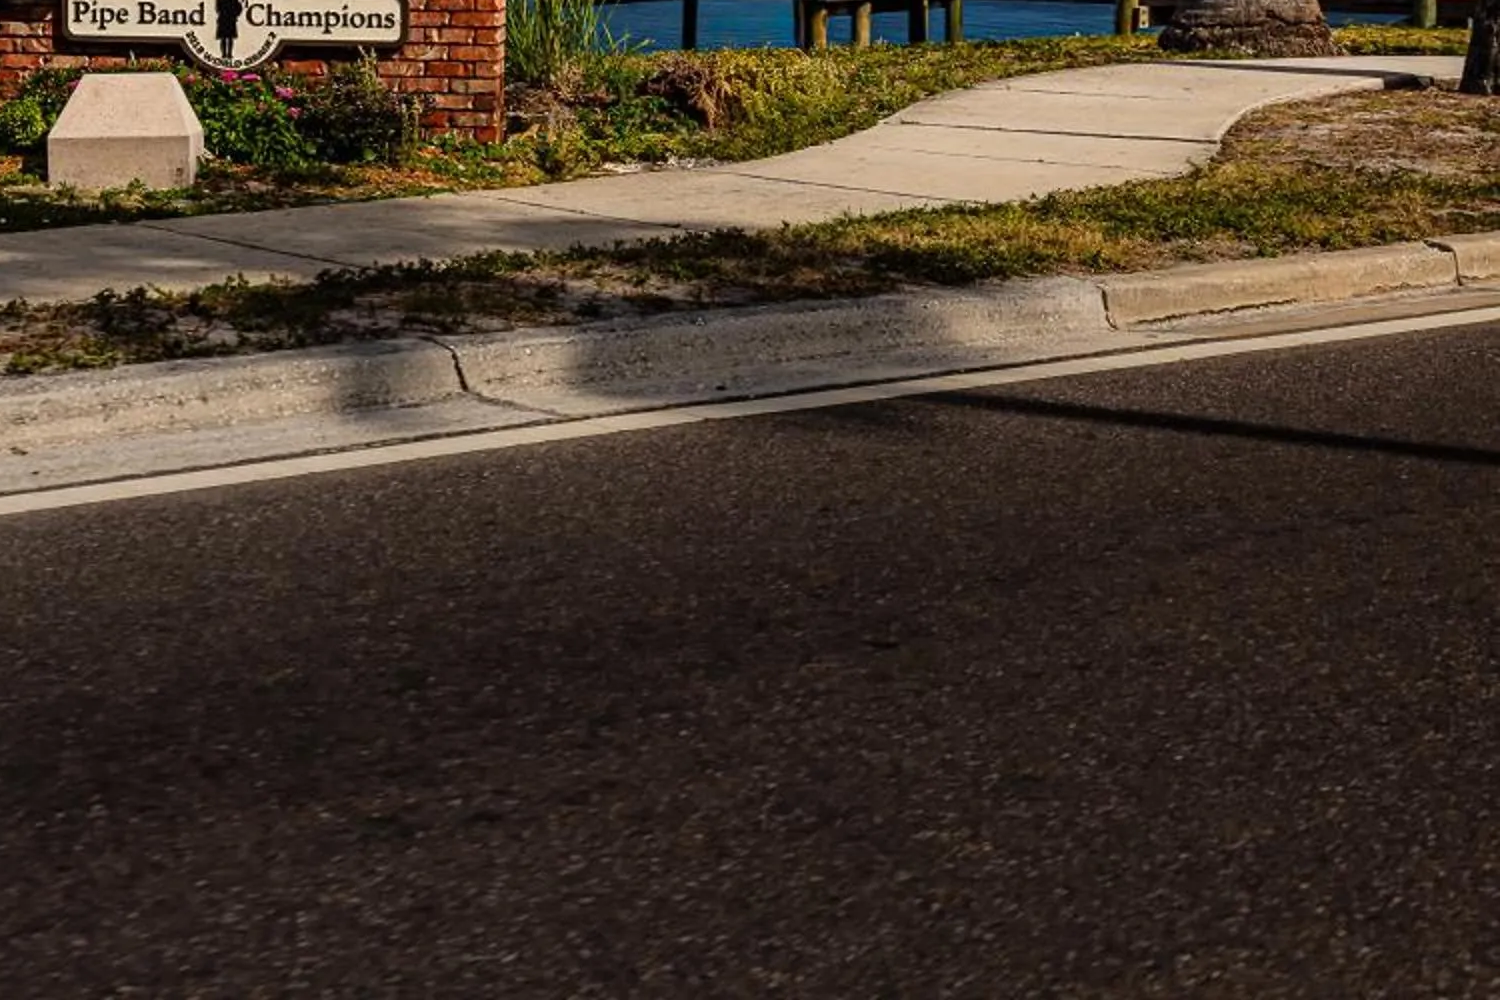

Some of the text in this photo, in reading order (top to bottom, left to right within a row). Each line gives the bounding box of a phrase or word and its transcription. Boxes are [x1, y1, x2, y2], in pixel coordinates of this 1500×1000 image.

[72, 0, 396, 34] Pipe Band Champions
